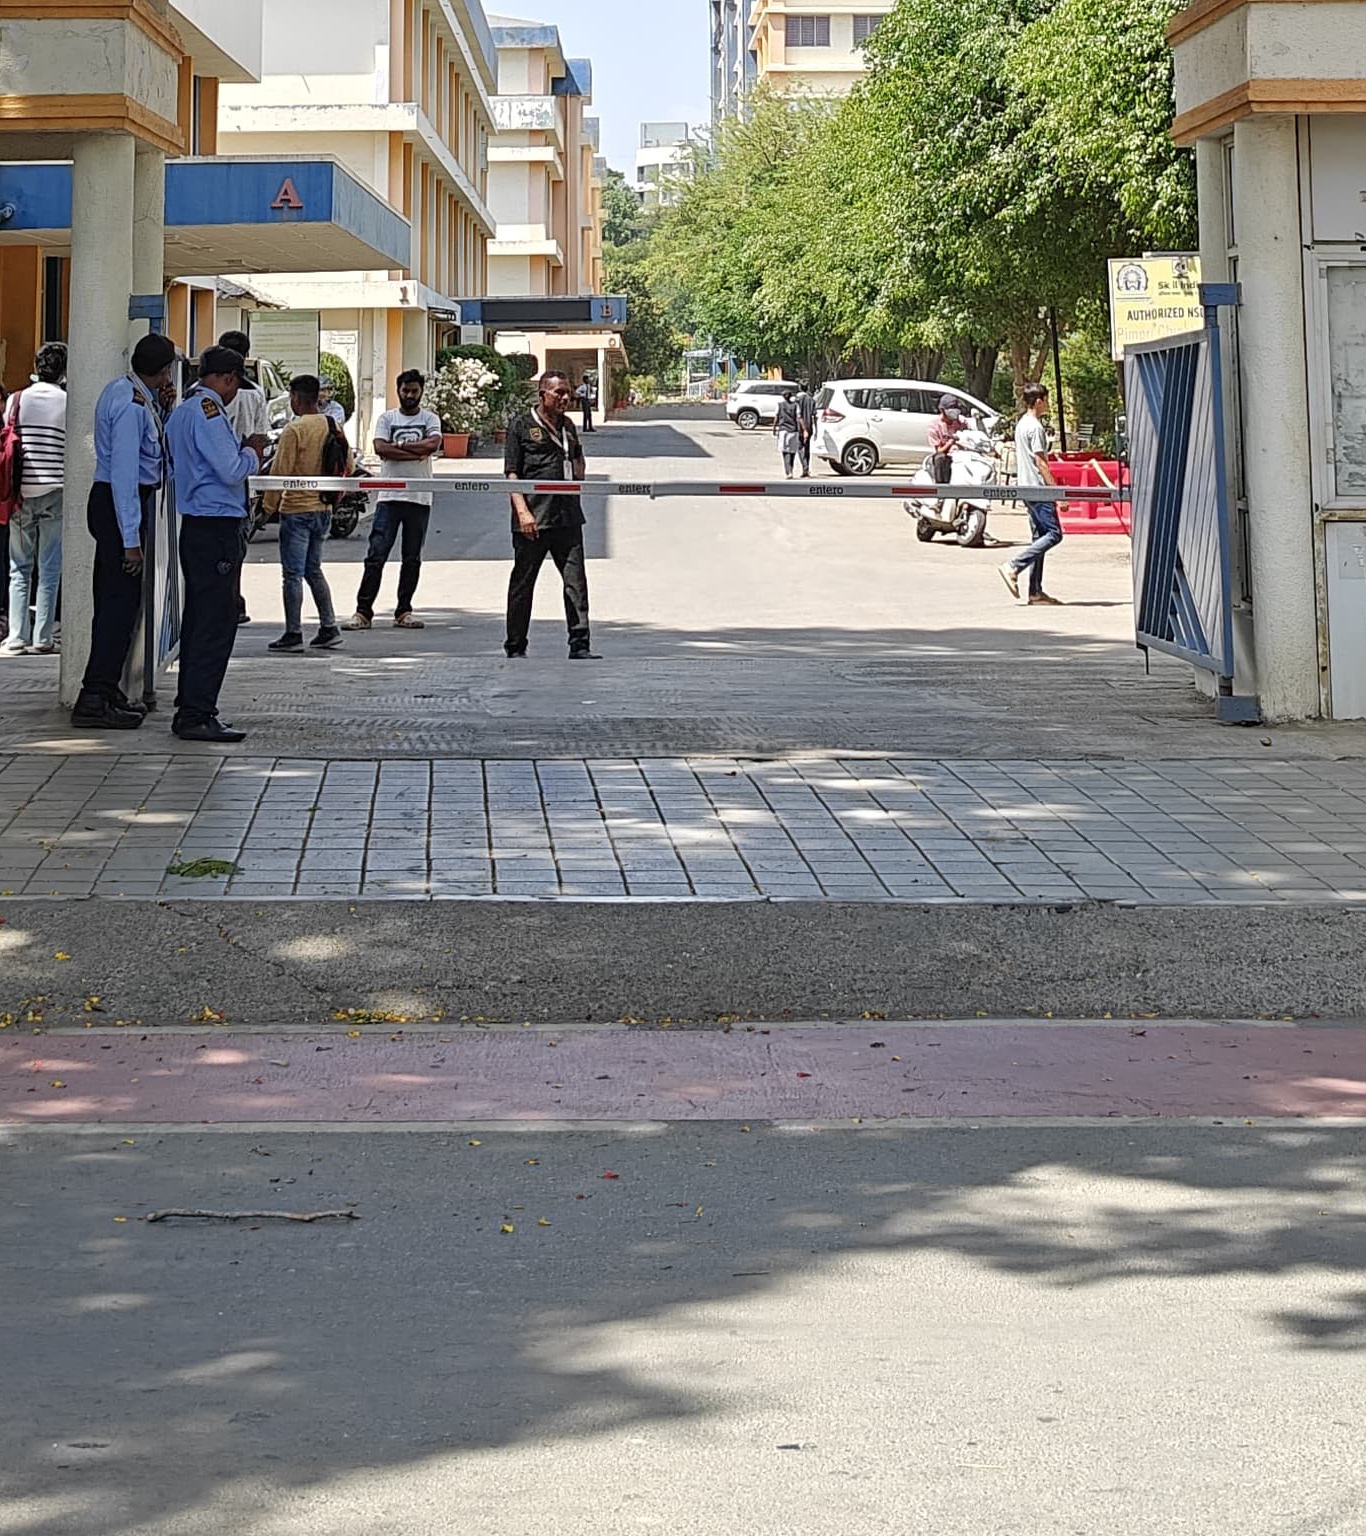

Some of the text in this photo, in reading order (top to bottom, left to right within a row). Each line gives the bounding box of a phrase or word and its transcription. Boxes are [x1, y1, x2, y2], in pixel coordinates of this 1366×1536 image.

[270, 176, 303, 208] A
[1127, 307, 1184, 321] AUTHORIZED
[455, 481, 490, 491] entero
[809, 484, 844, 496] entero
[983, 486, 1018, 498] entero
